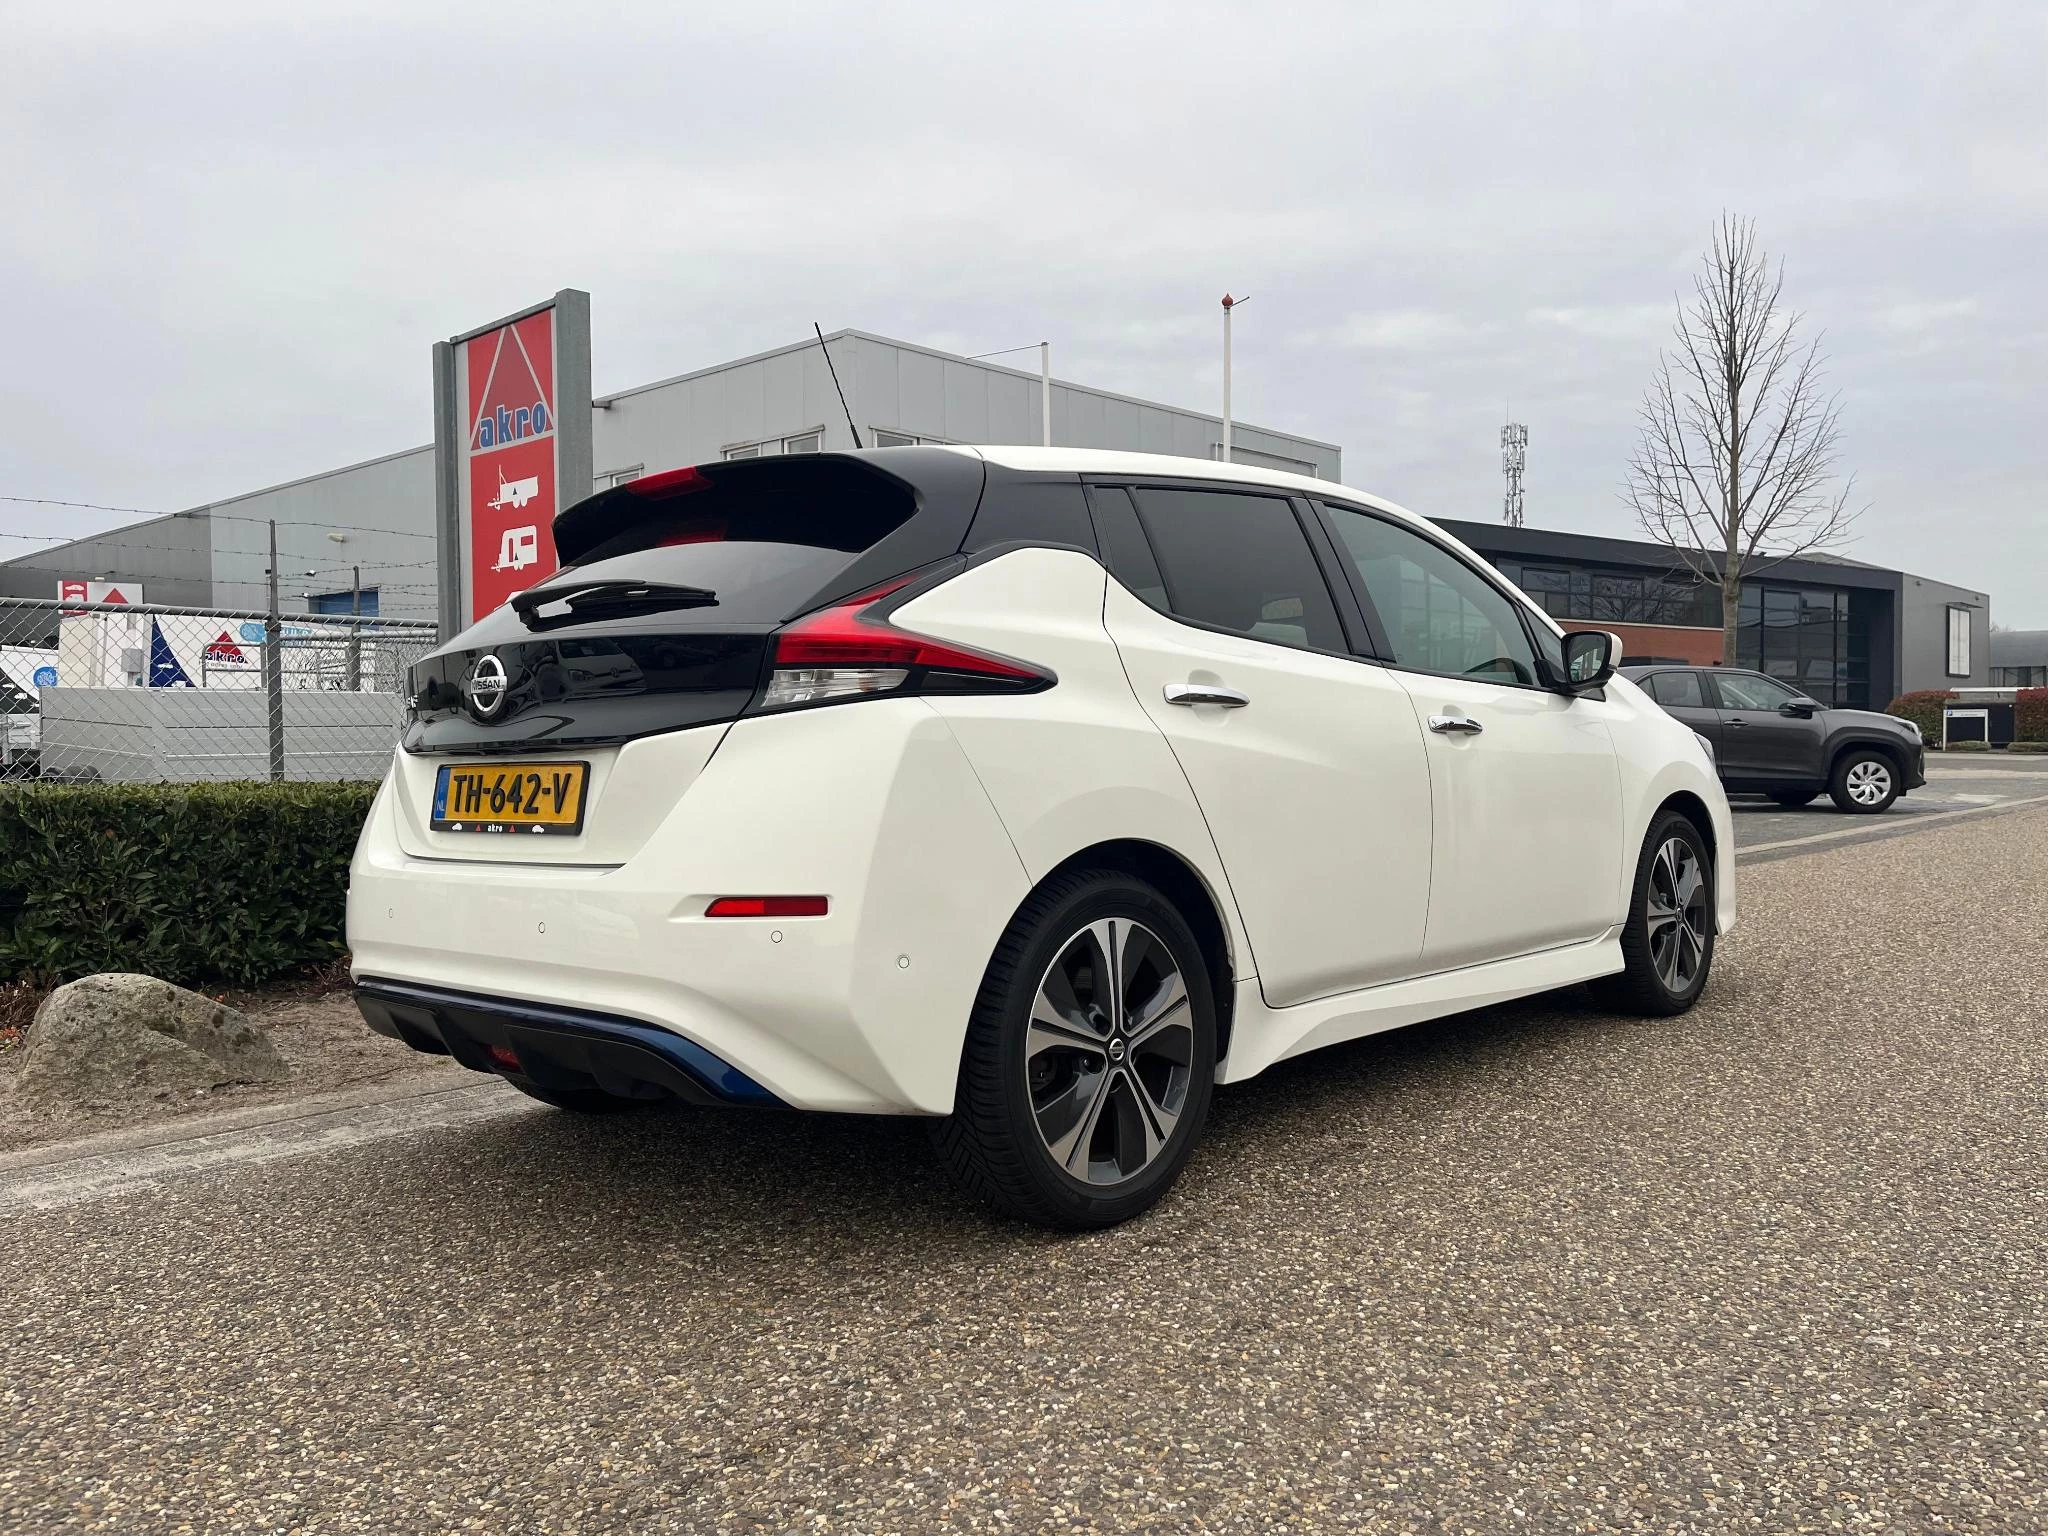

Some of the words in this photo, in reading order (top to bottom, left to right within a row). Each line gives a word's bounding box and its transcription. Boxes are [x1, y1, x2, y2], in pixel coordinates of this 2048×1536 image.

[479, 401, 547, 449] akro
[471, 679, 501, 691] NISSAN
[453, 773, 573, 815] TH-642-V
[487, 823, 503, 833] akro
